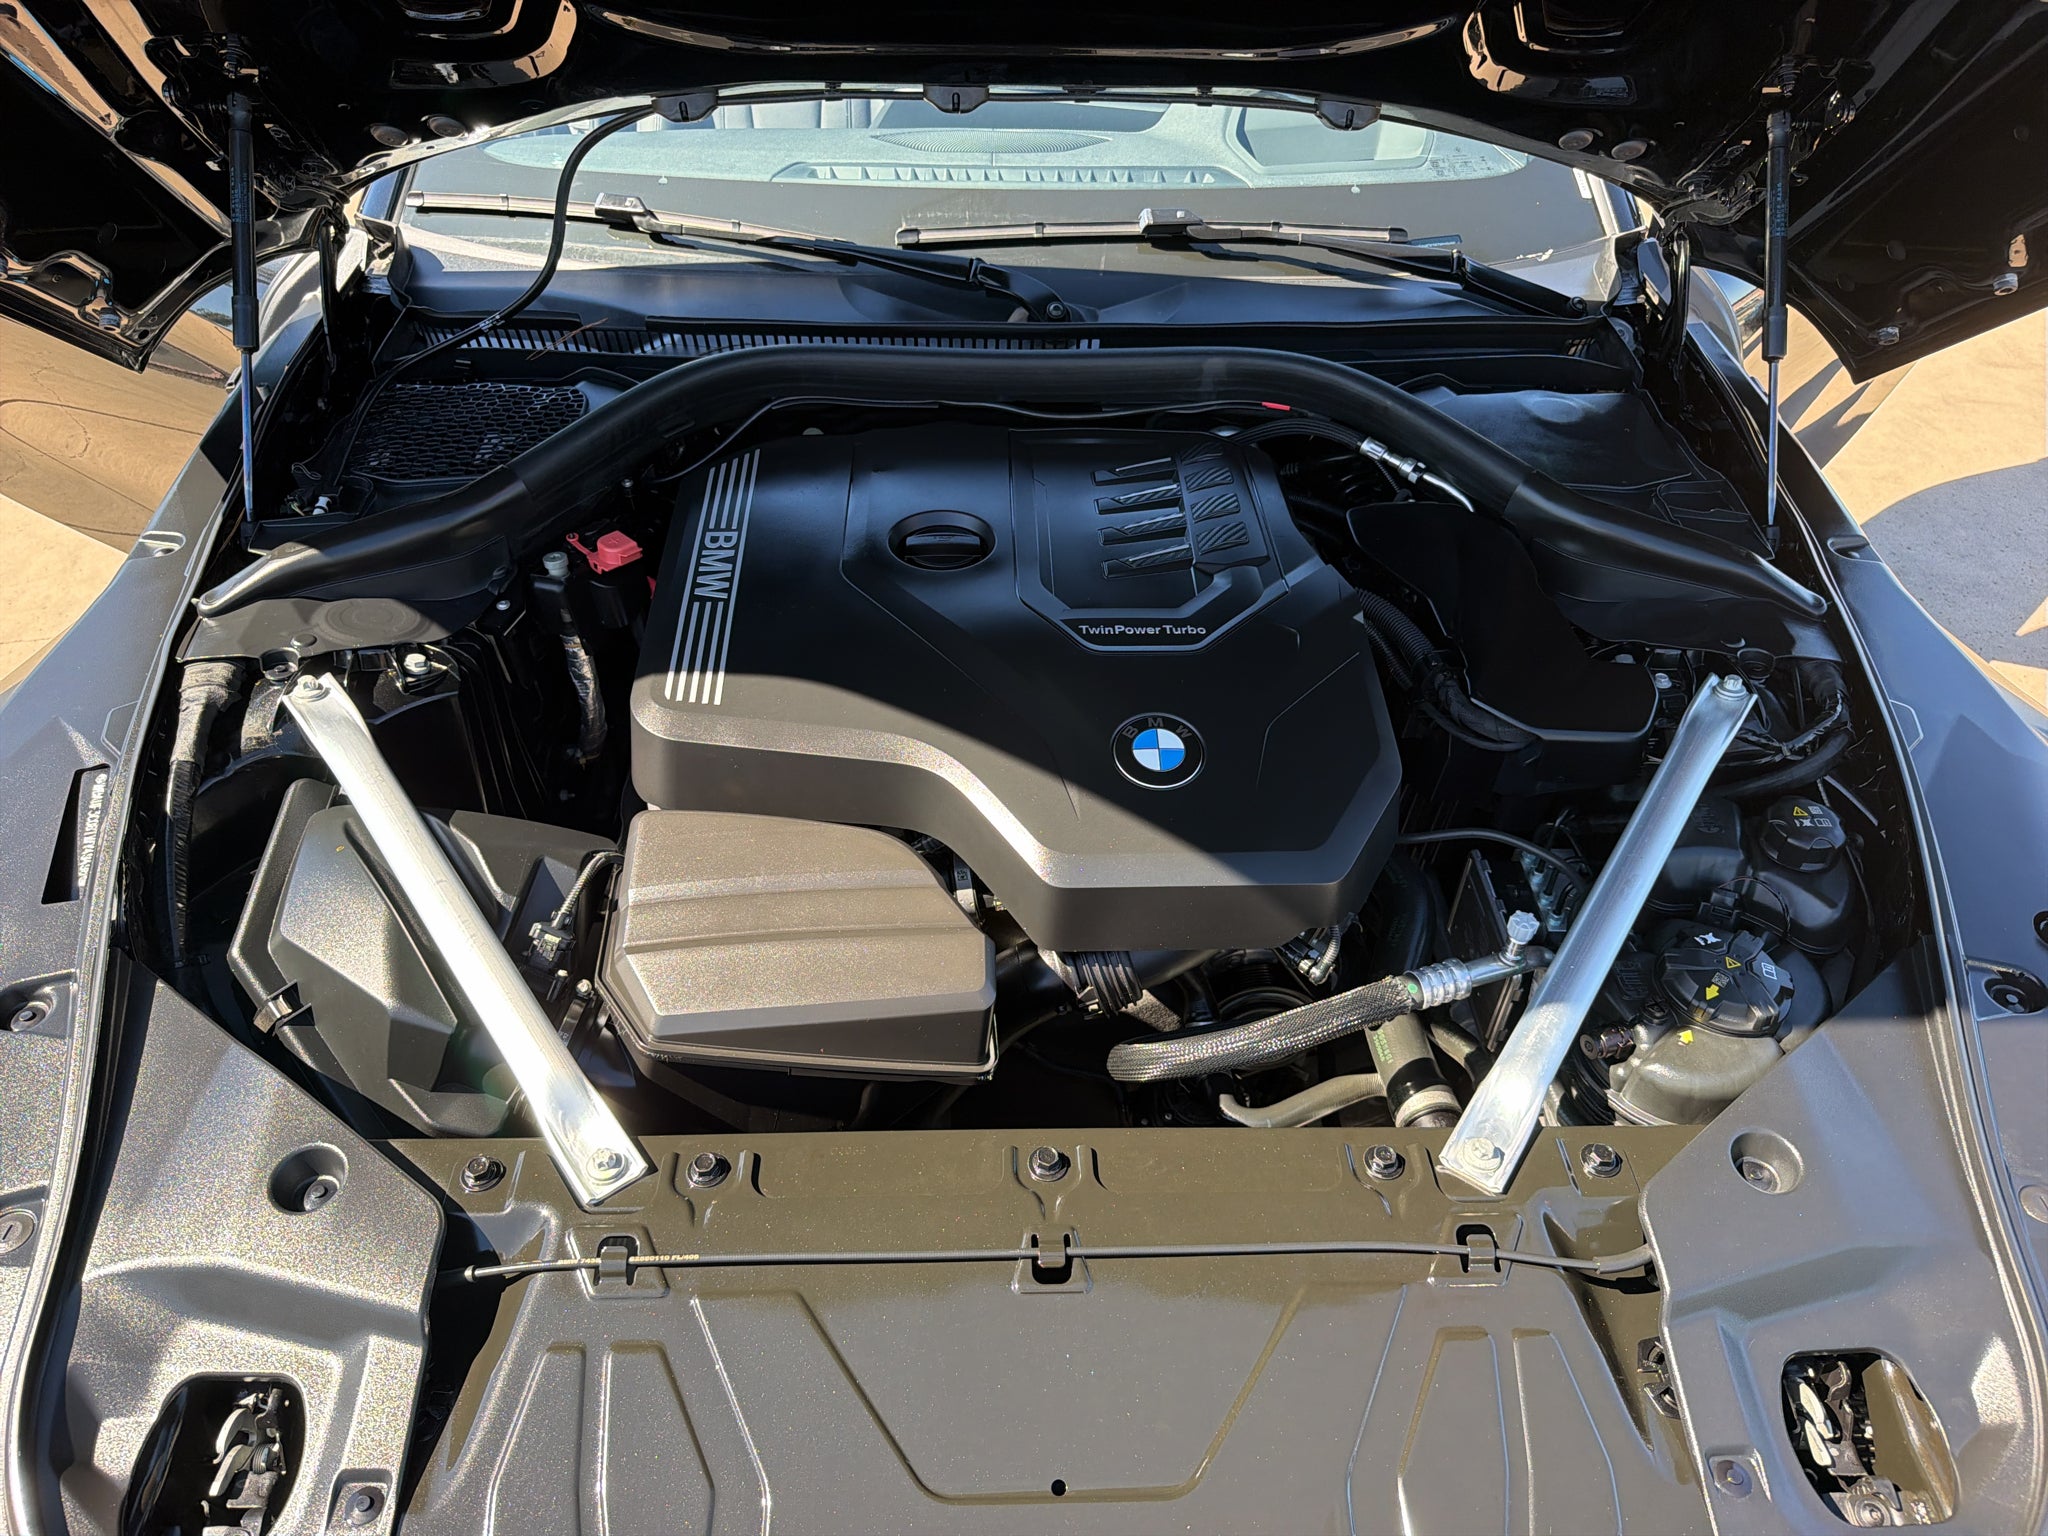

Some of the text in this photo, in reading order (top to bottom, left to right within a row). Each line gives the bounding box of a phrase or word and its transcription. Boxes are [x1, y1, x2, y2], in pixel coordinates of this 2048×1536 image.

[693, 531, 739, 599] BMW
[1162, 625, 1207, 635] Turbo
[1121, 717, 1193, 739] BMW
